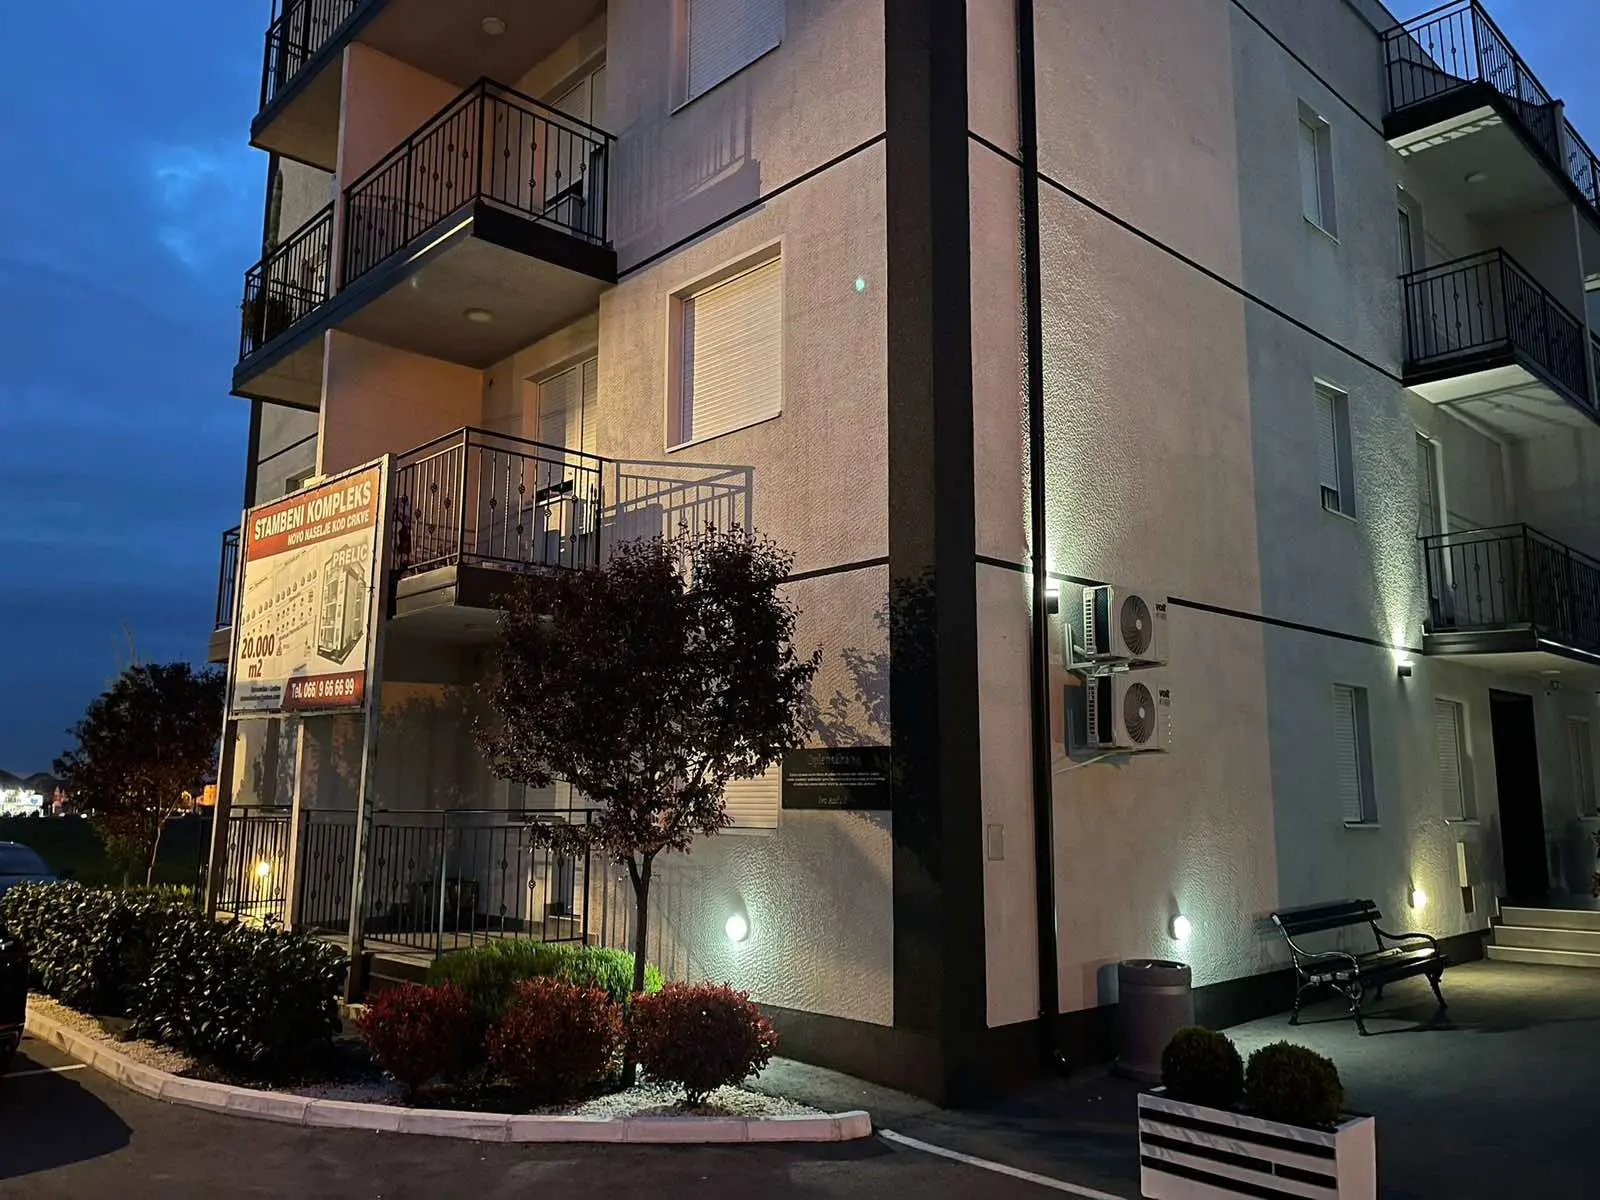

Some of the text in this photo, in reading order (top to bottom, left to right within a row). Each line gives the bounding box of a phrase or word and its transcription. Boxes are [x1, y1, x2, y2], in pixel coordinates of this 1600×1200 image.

[254, 481, 371, 540] STAMBENI KOMPLEKS
[287, 509, 369, 546] NOVO NASELJE KOD CRKVE
[241, 633, 275, 660] 20.000
[248, 658, 264, 679] m2
[324, 679, 334, 697] 66
[335, 678, 345, 696] 66
[345, 677, 355, 696] 99
